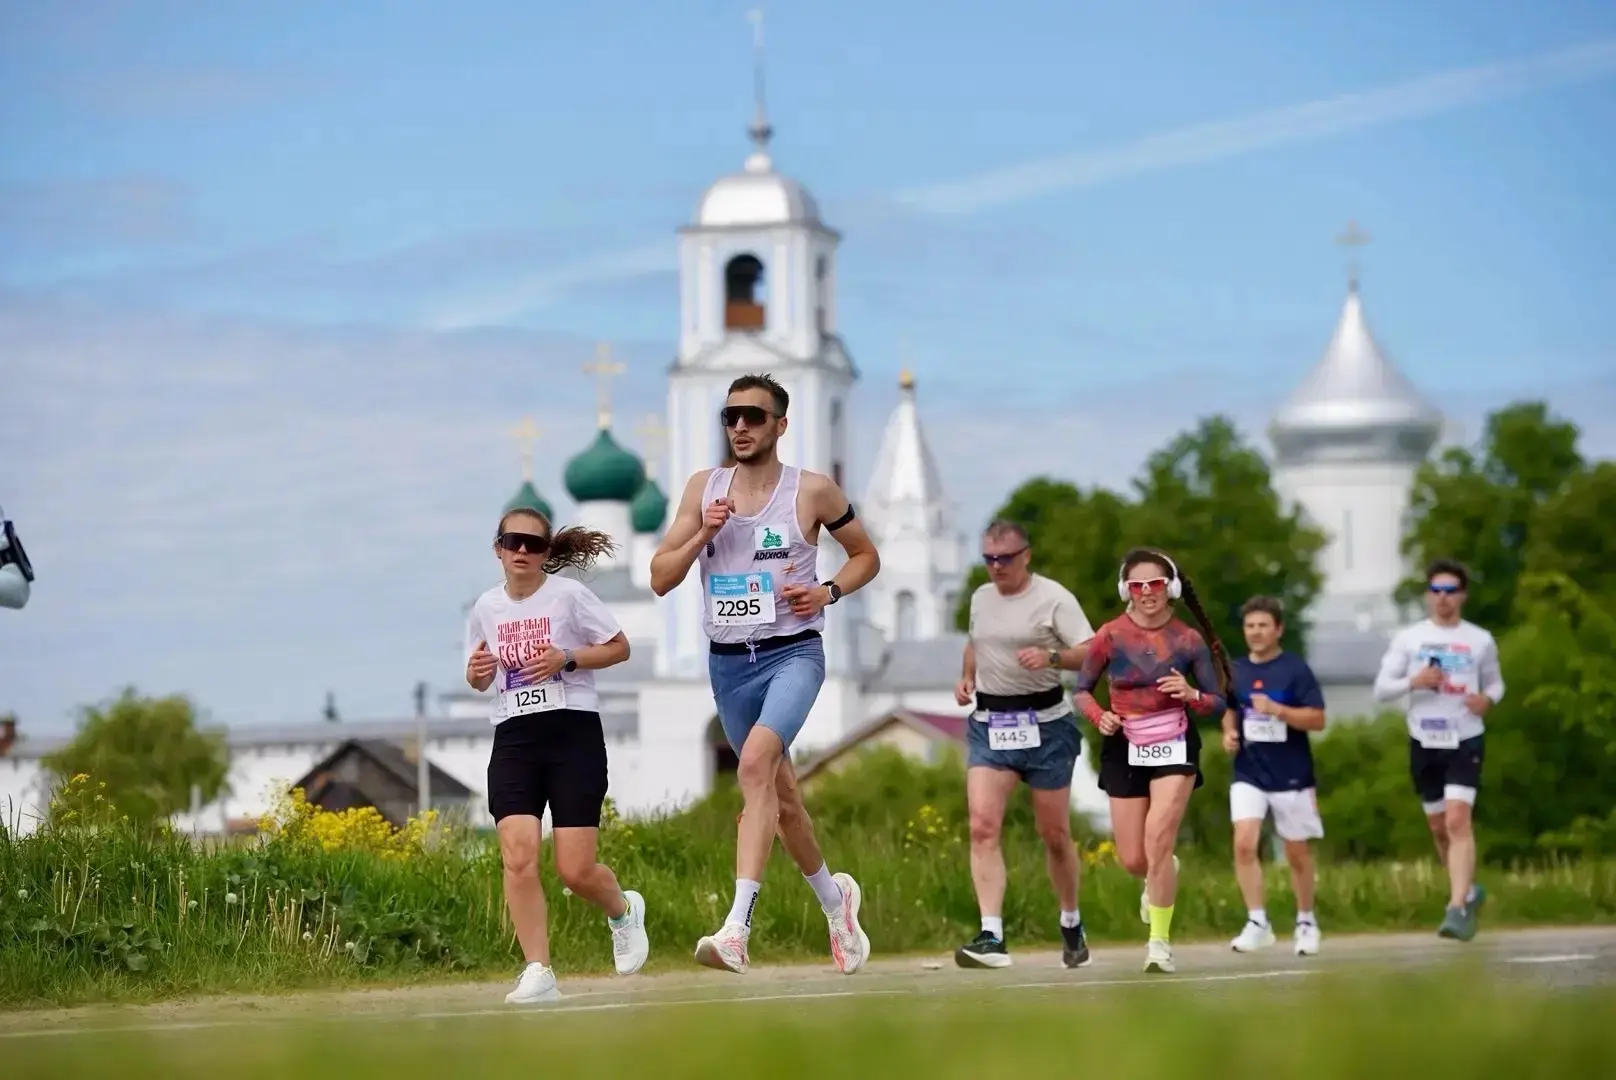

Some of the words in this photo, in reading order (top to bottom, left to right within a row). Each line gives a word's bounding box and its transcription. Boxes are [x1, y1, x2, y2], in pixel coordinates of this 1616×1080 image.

[753, 551, 789, 561] ADIXION
[717, 599, 760, 616] 2295
[515, 688, 547, 707] 1251
[994, 730, 1028, 743] 1445
[1137, 745, 1172, 758] 1589
